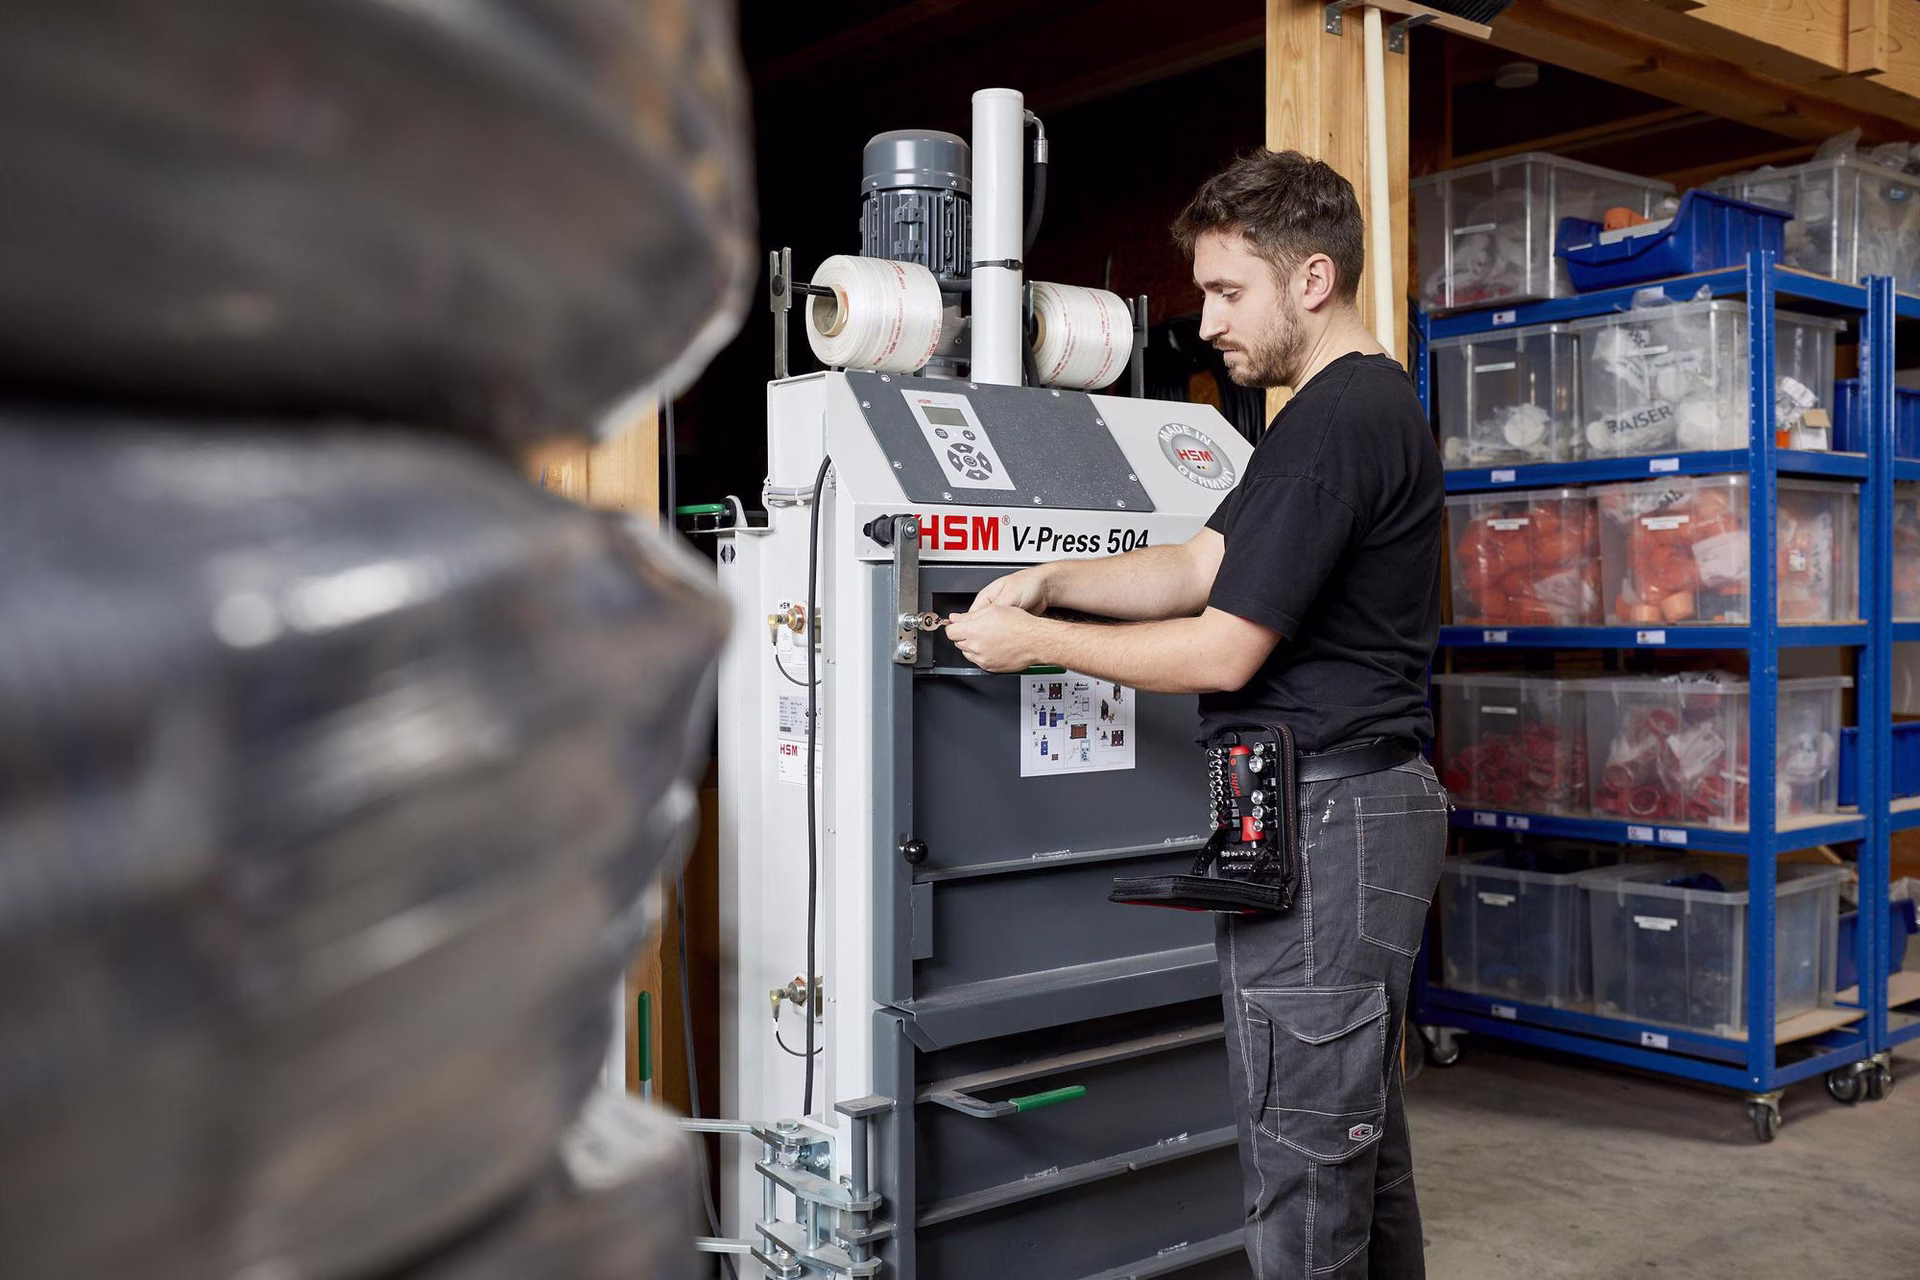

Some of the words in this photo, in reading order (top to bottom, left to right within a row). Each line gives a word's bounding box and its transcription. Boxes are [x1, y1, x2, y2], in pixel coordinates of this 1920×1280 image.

[1160, 424, 1190, 442] MADE
[1195, 431, 1211, 446] IN
[1176, 449, 1214, 462] HSM
[1177, 465, 1234, 490] GERMANY
[1012, 526, 1100, 553] V-Press
[1107, 529, 1149, 554] 504
[780, 743, 798, 756] HSM
